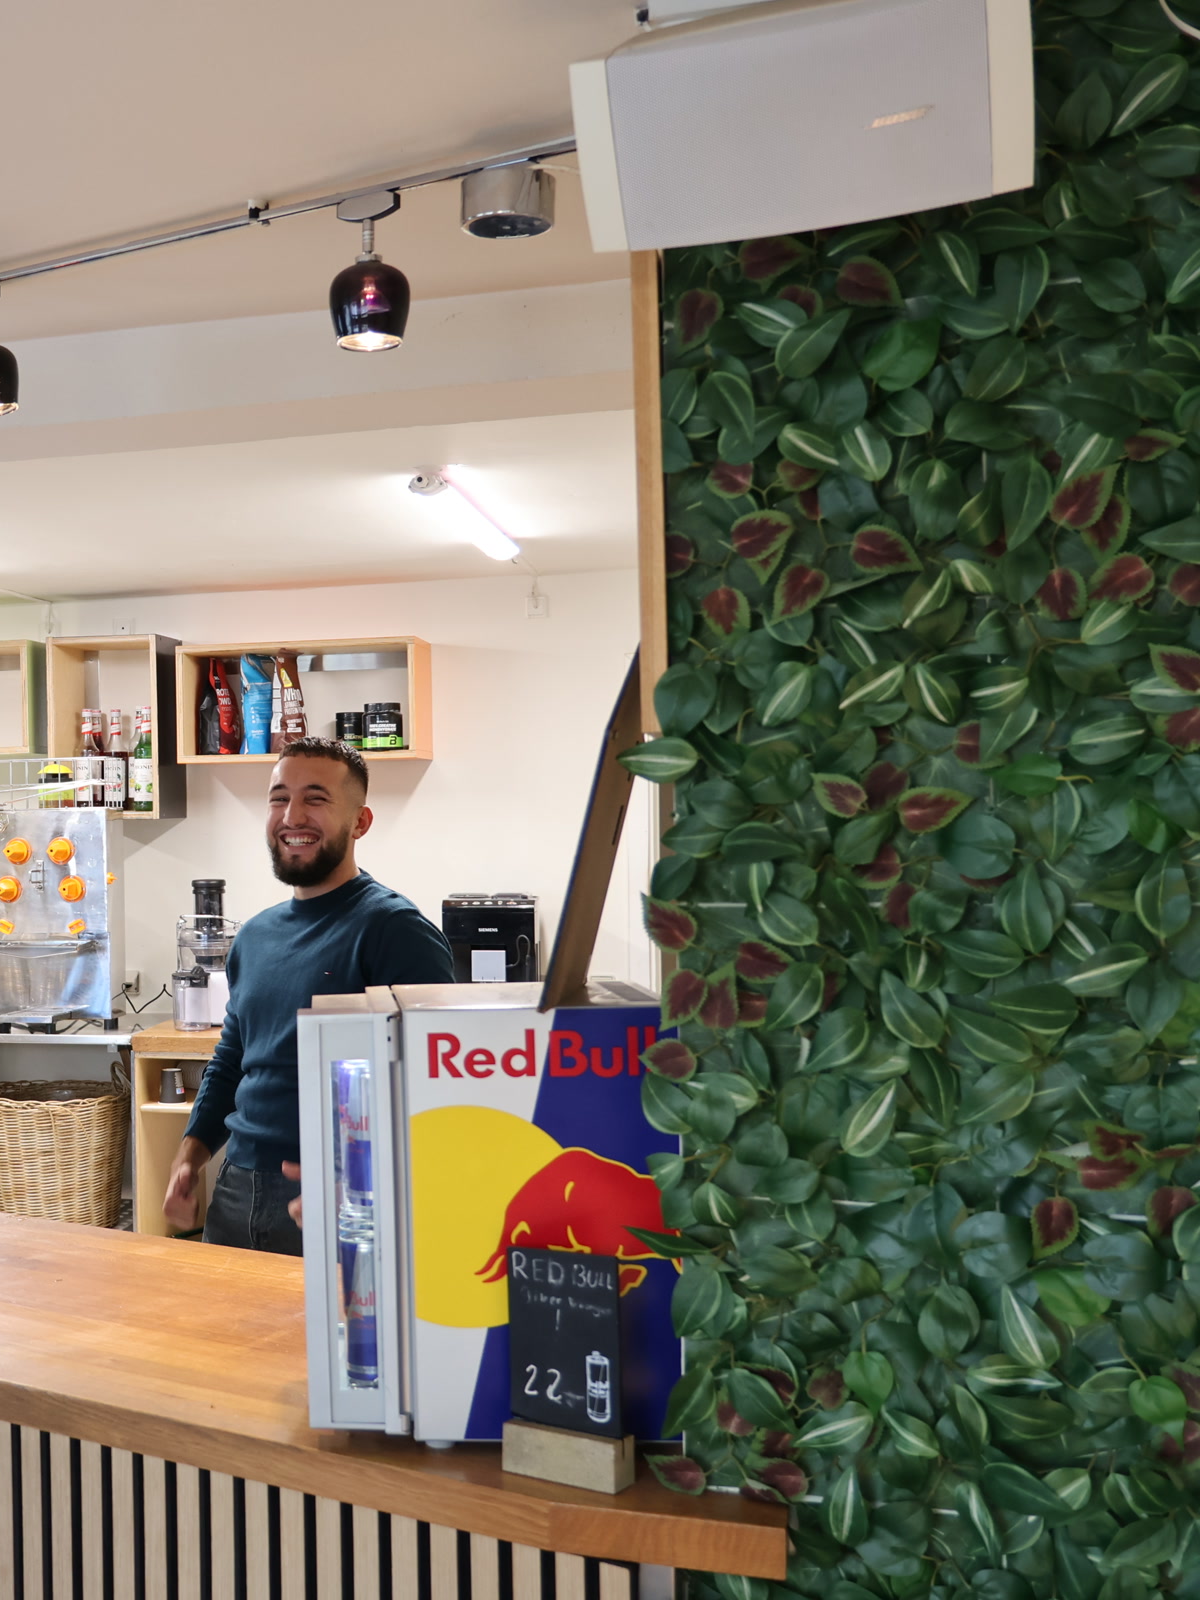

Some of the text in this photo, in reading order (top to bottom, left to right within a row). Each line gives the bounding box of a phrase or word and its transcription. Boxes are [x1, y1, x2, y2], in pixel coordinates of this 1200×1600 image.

[427, 1028, 536, 1079] Red
[511, 1250, 614, 1291] RED BULL
